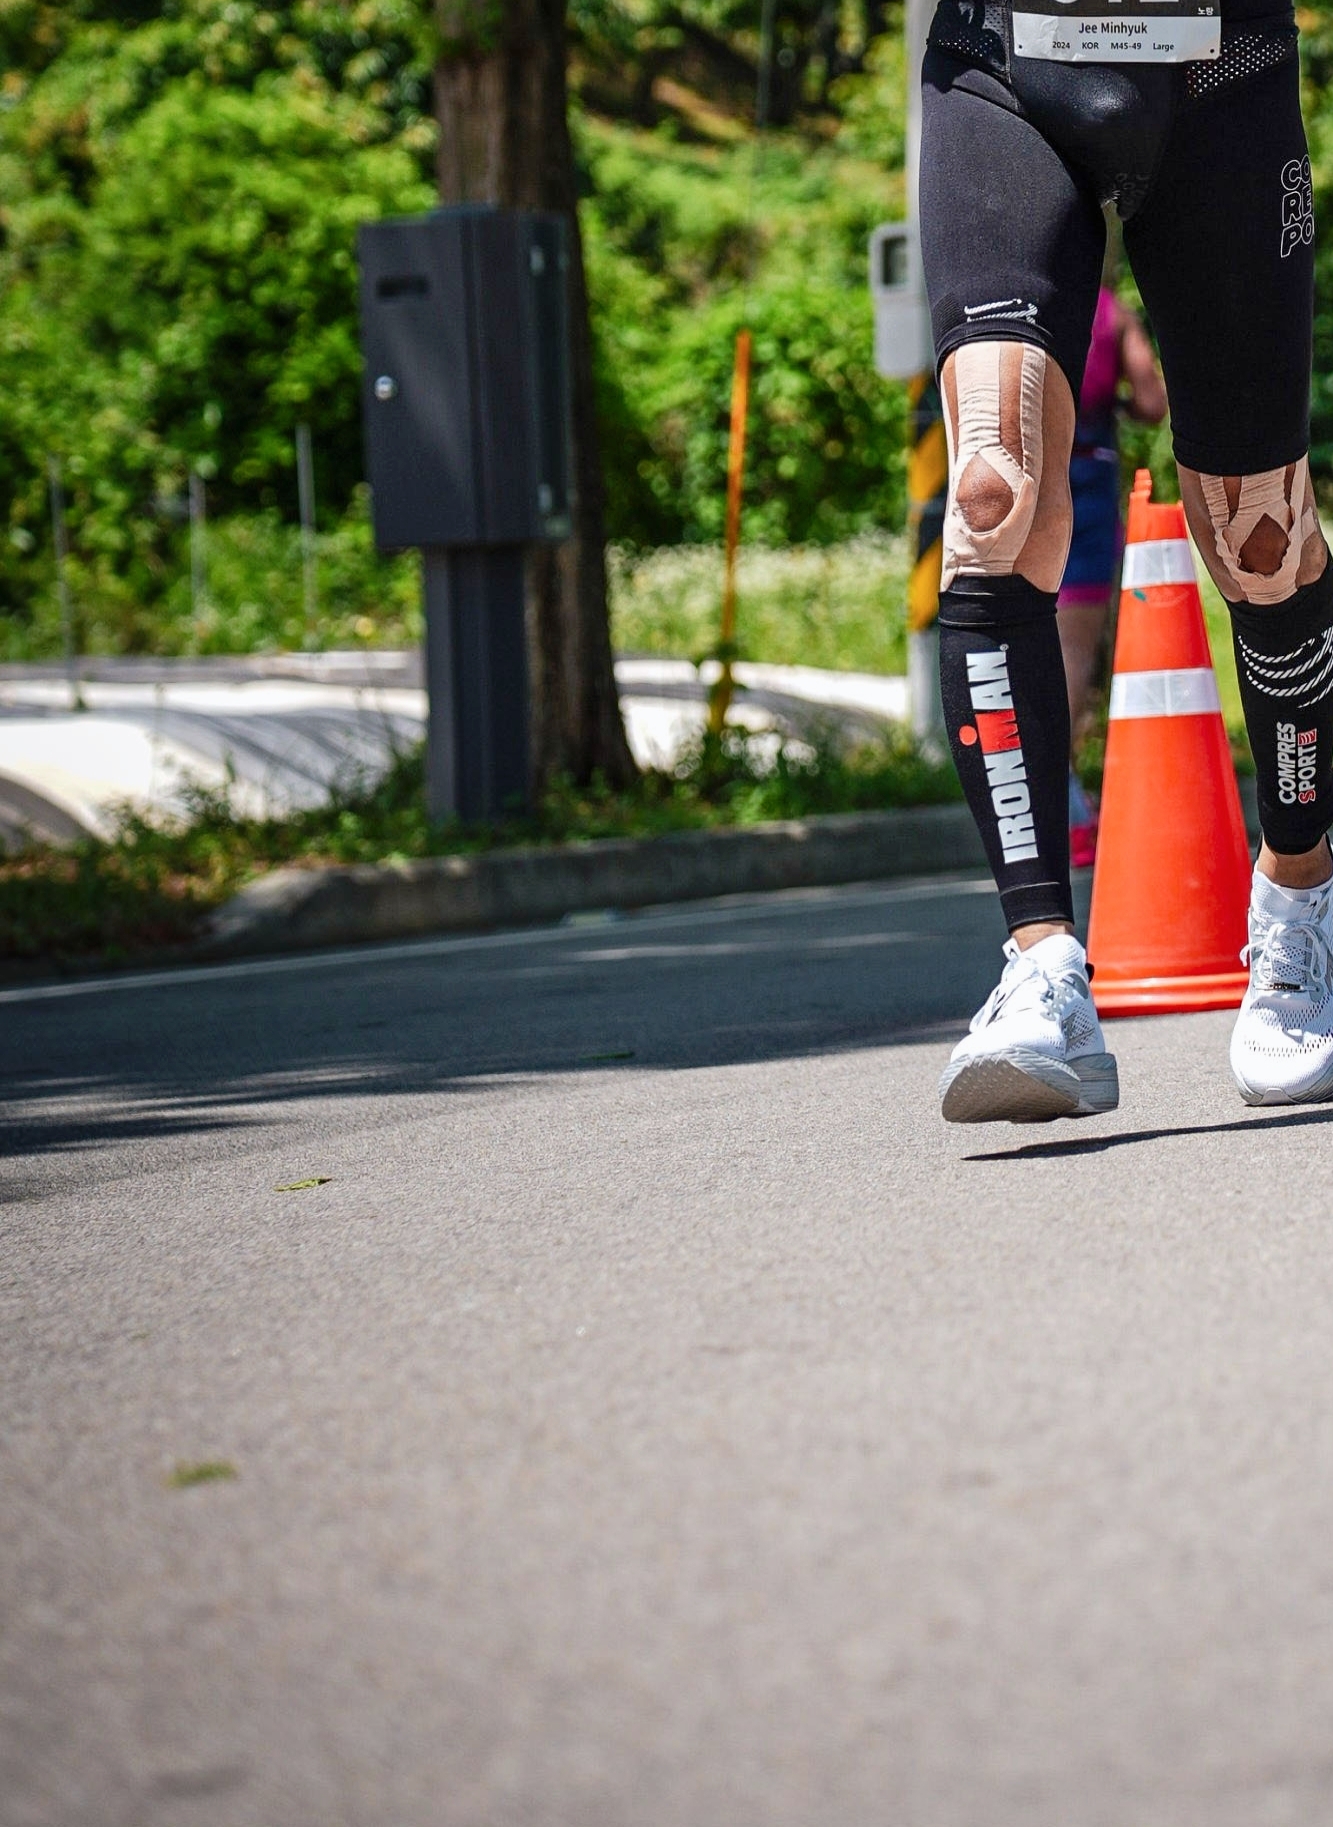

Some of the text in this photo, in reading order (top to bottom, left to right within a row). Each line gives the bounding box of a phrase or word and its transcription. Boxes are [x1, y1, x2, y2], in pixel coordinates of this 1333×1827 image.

[1052, 41, 1175, 52] 2024 KOR M45-49 Large
[1078, 22, 1148, 37] Jee Minhyuk
[959, 649, 1040, 864] IRONMAN
[1276, 721, 1297, 804] COMPRES
[1297, 744, 1316, 804] SPORT
